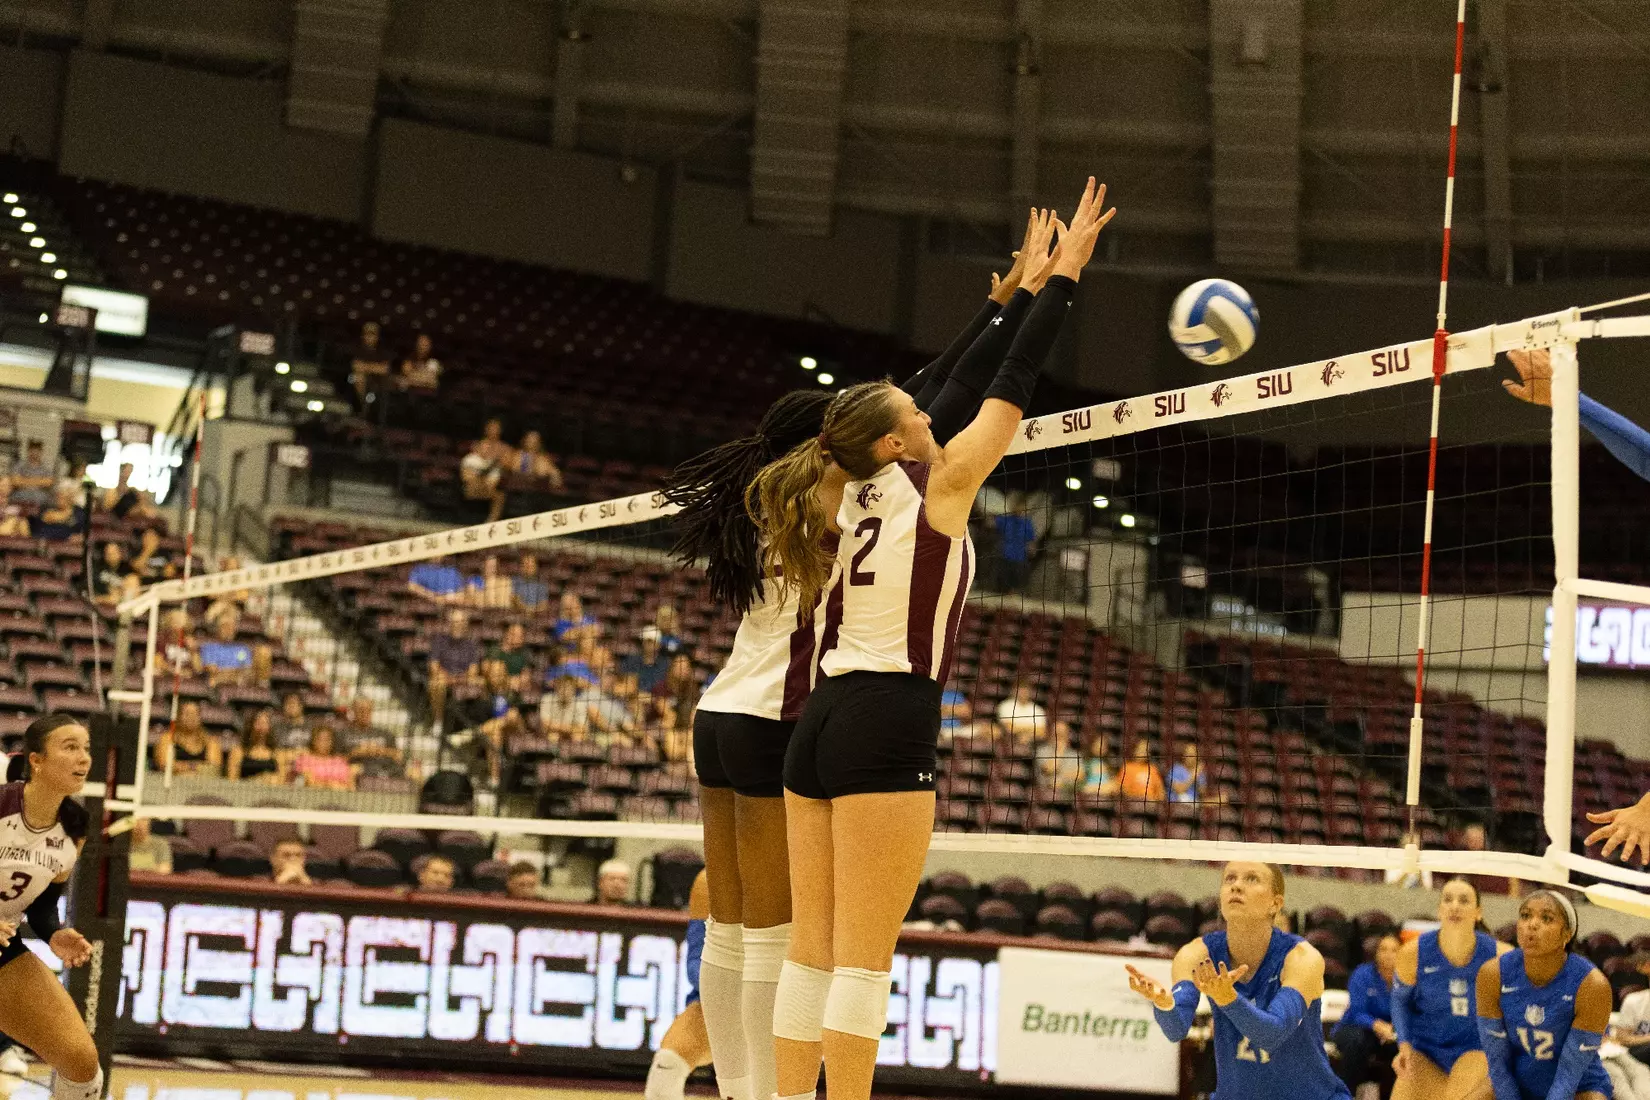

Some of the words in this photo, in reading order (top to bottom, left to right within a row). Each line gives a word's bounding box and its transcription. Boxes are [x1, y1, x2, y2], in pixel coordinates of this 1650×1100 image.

[1062, 410, 1091, 434] SIU
[1155, 393, 1186, 417] SIU
[1257, 372, 1292, 399] SIU
[1372, 348, 1410, 377] SIU
[507, 521, 522, 536] SIU
[552, 512, 568, 528] SIU
[599, 503, 616, 519] SIU
[850, 517, 882, 586] 2
[0, 871, 32, 901] 3
[1022, 1003, 1149, 1041] Banterra
[1516, 1027, 1554, 1060] 12
